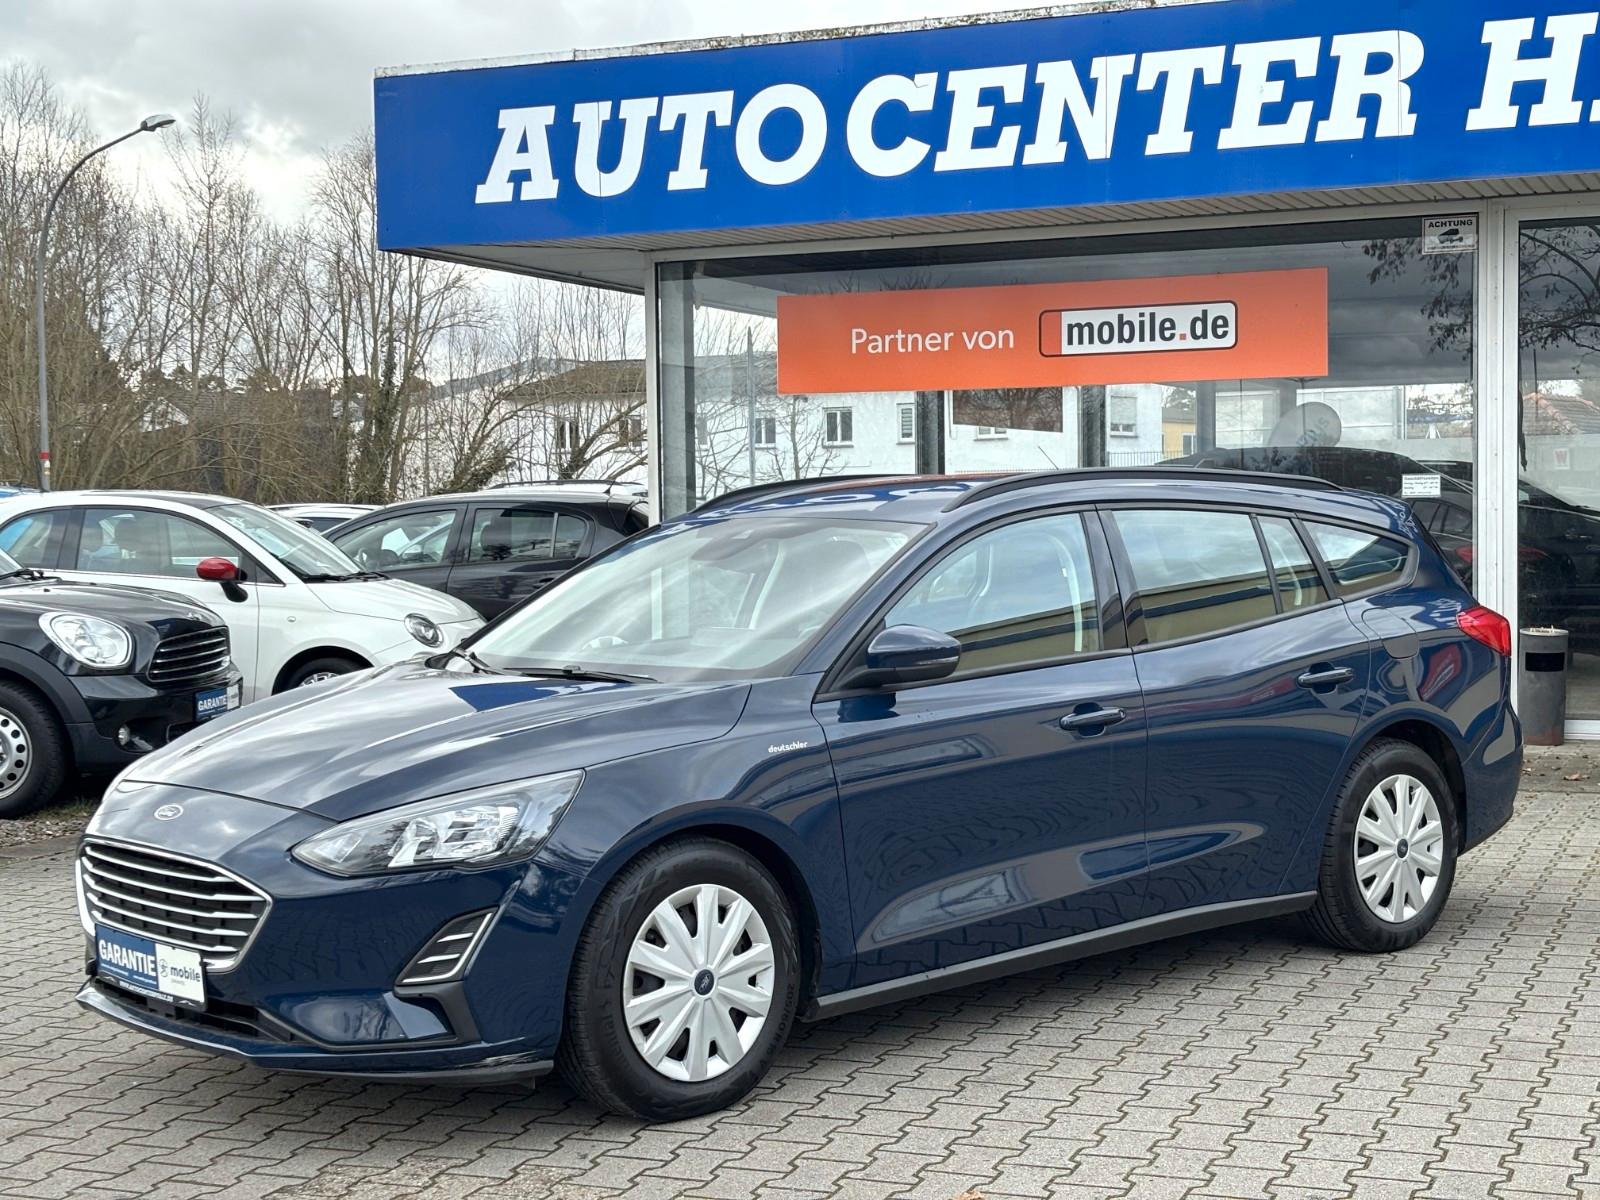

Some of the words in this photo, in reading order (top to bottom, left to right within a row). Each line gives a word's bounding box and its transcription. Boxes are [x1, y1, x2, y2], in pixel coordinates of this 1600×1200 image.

[1465, 11, 1600, 131] H
[1428, 219, 1473, 228] ACHTUNG
[850, 327, 960, 354] Partner
[961, 328, 1015, 351] von
[1065, 309, 1230, 346] mobile.de
[98, 939, 157, 977] GARANTIE
[170, 966, 201, 983] mobile
